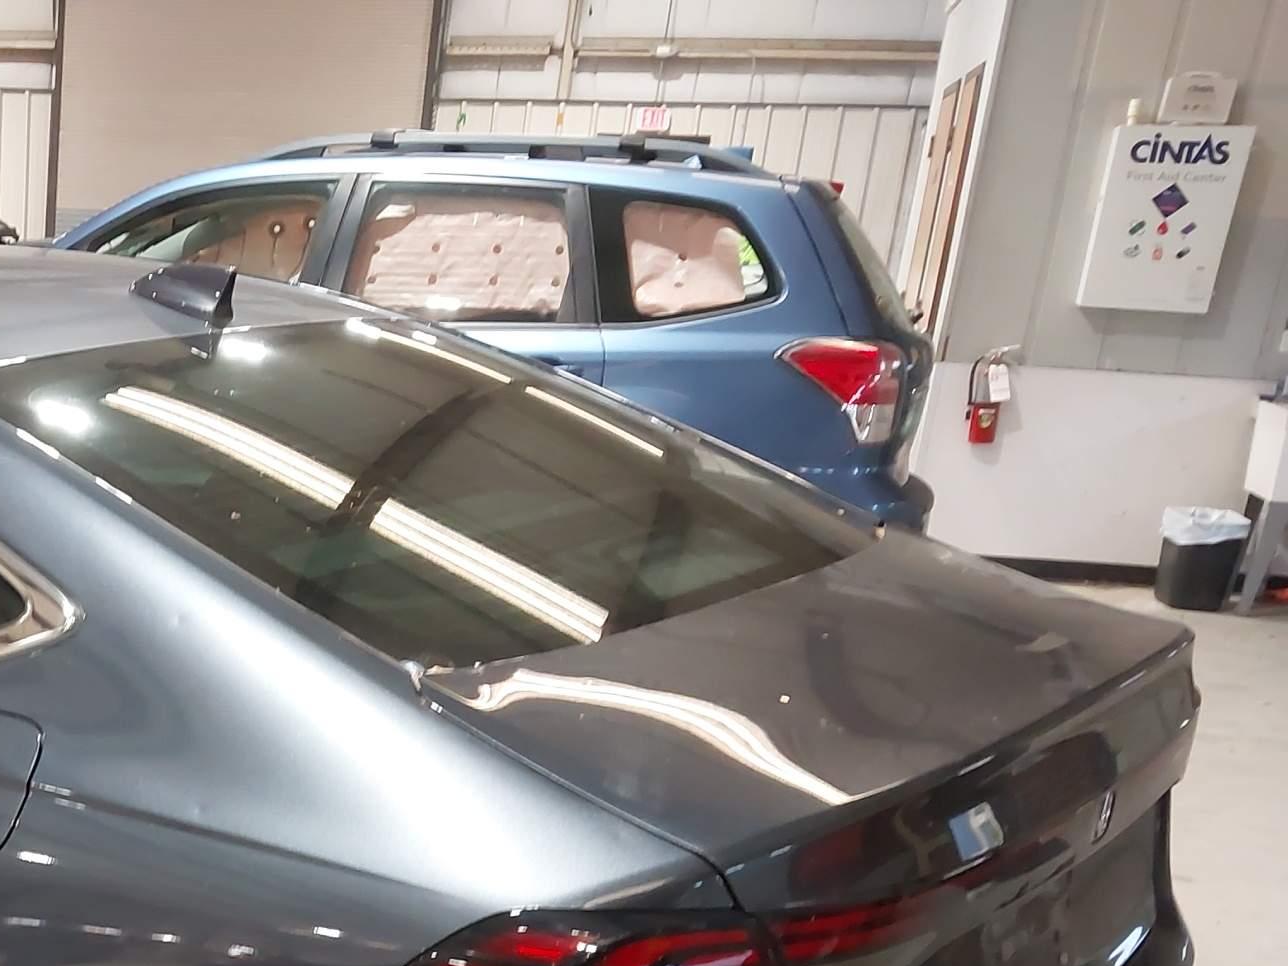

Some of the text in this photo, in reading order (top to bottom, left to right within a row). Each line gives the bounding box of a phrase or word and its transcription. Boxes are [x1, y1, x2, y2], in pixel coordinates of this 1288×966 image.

[641, 108, 667, 129] EXIT
[1126, 170, 1227, 183] First Aid Center
